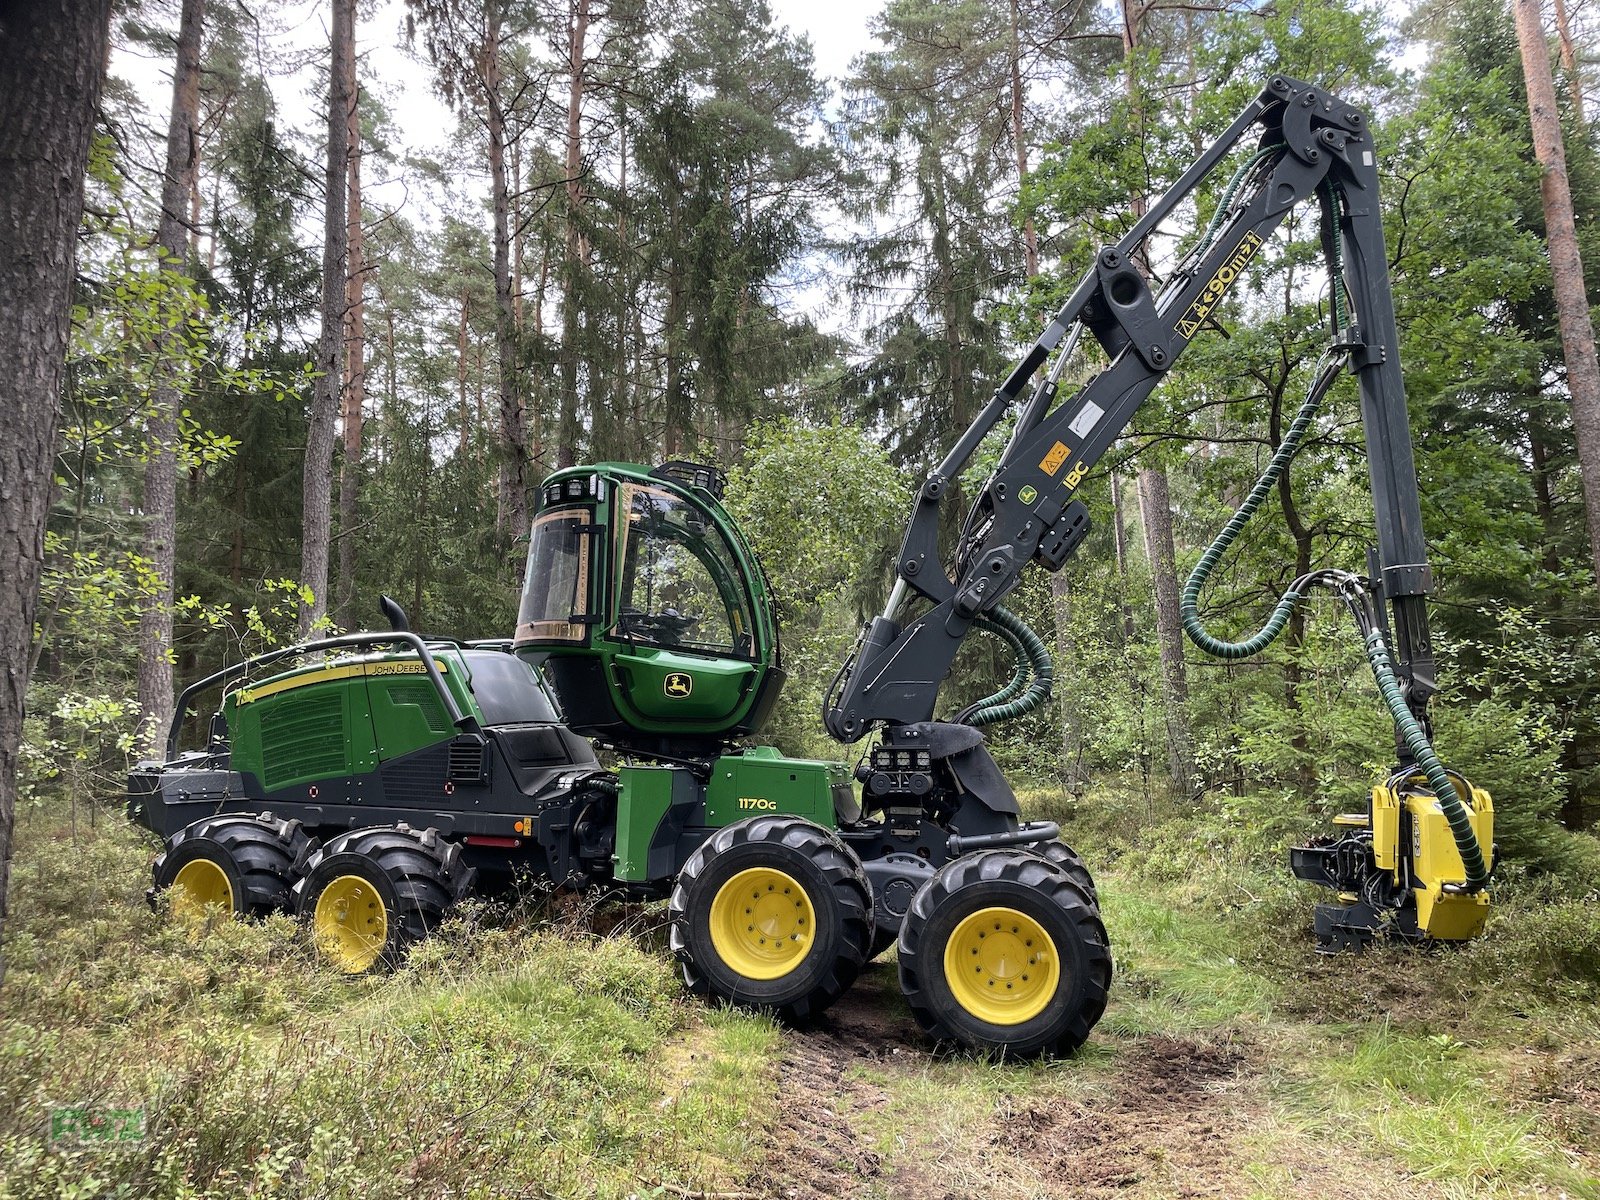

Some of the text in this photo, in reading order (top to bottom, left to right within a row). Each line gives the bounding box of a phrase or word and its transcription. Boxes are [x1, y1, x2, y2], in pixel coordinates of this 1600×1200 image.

[1062, 460, 1090, 491] IBC
[372, 663, 426, 675] JOHN DEERE
[738, 797, 777, 810] 1170G
